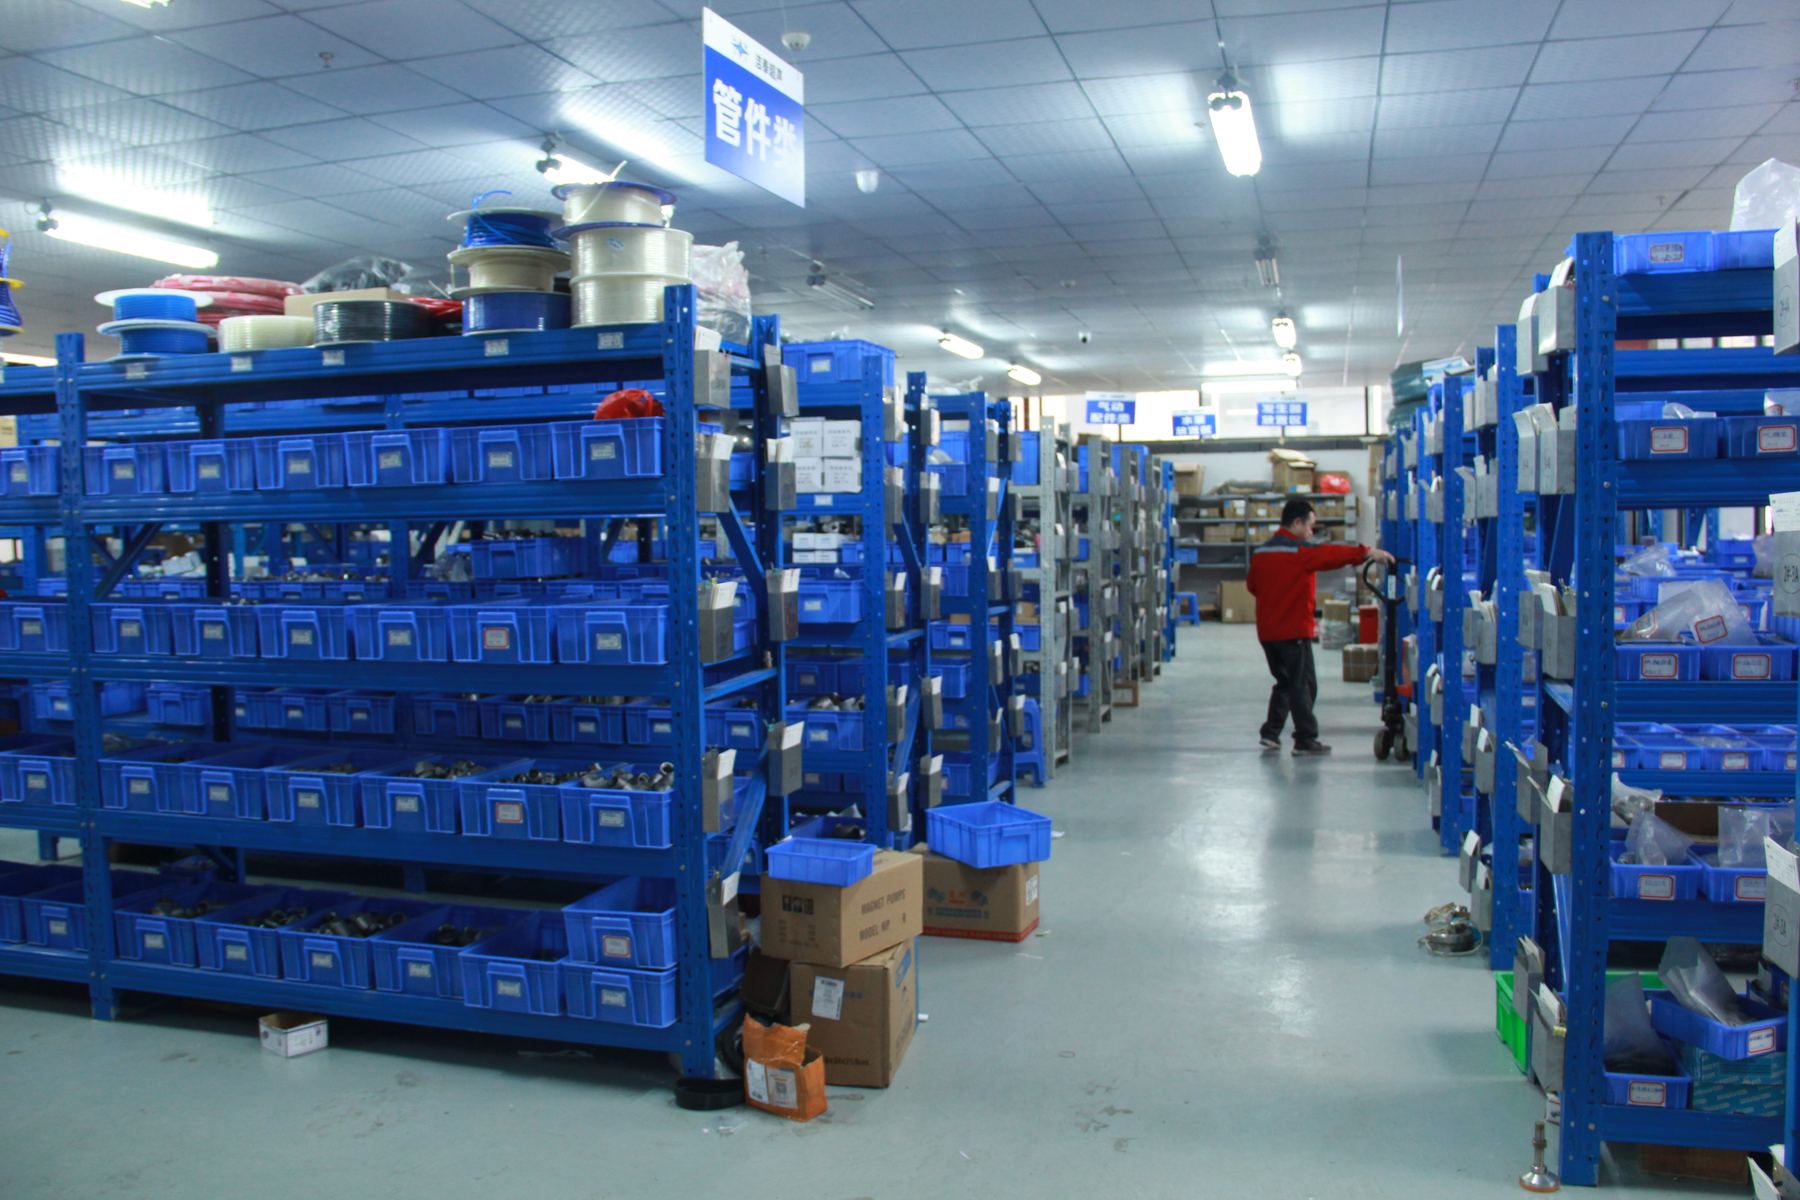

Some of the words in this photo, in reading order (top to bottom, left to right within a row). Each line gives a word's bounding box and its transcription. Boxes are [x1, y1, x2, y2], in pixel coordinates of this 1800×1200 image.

[861, 896, 885, 915] MAGNET
[886, 888, 906, 905] PUMPS
[859, 924, 879, 941] MODEL
